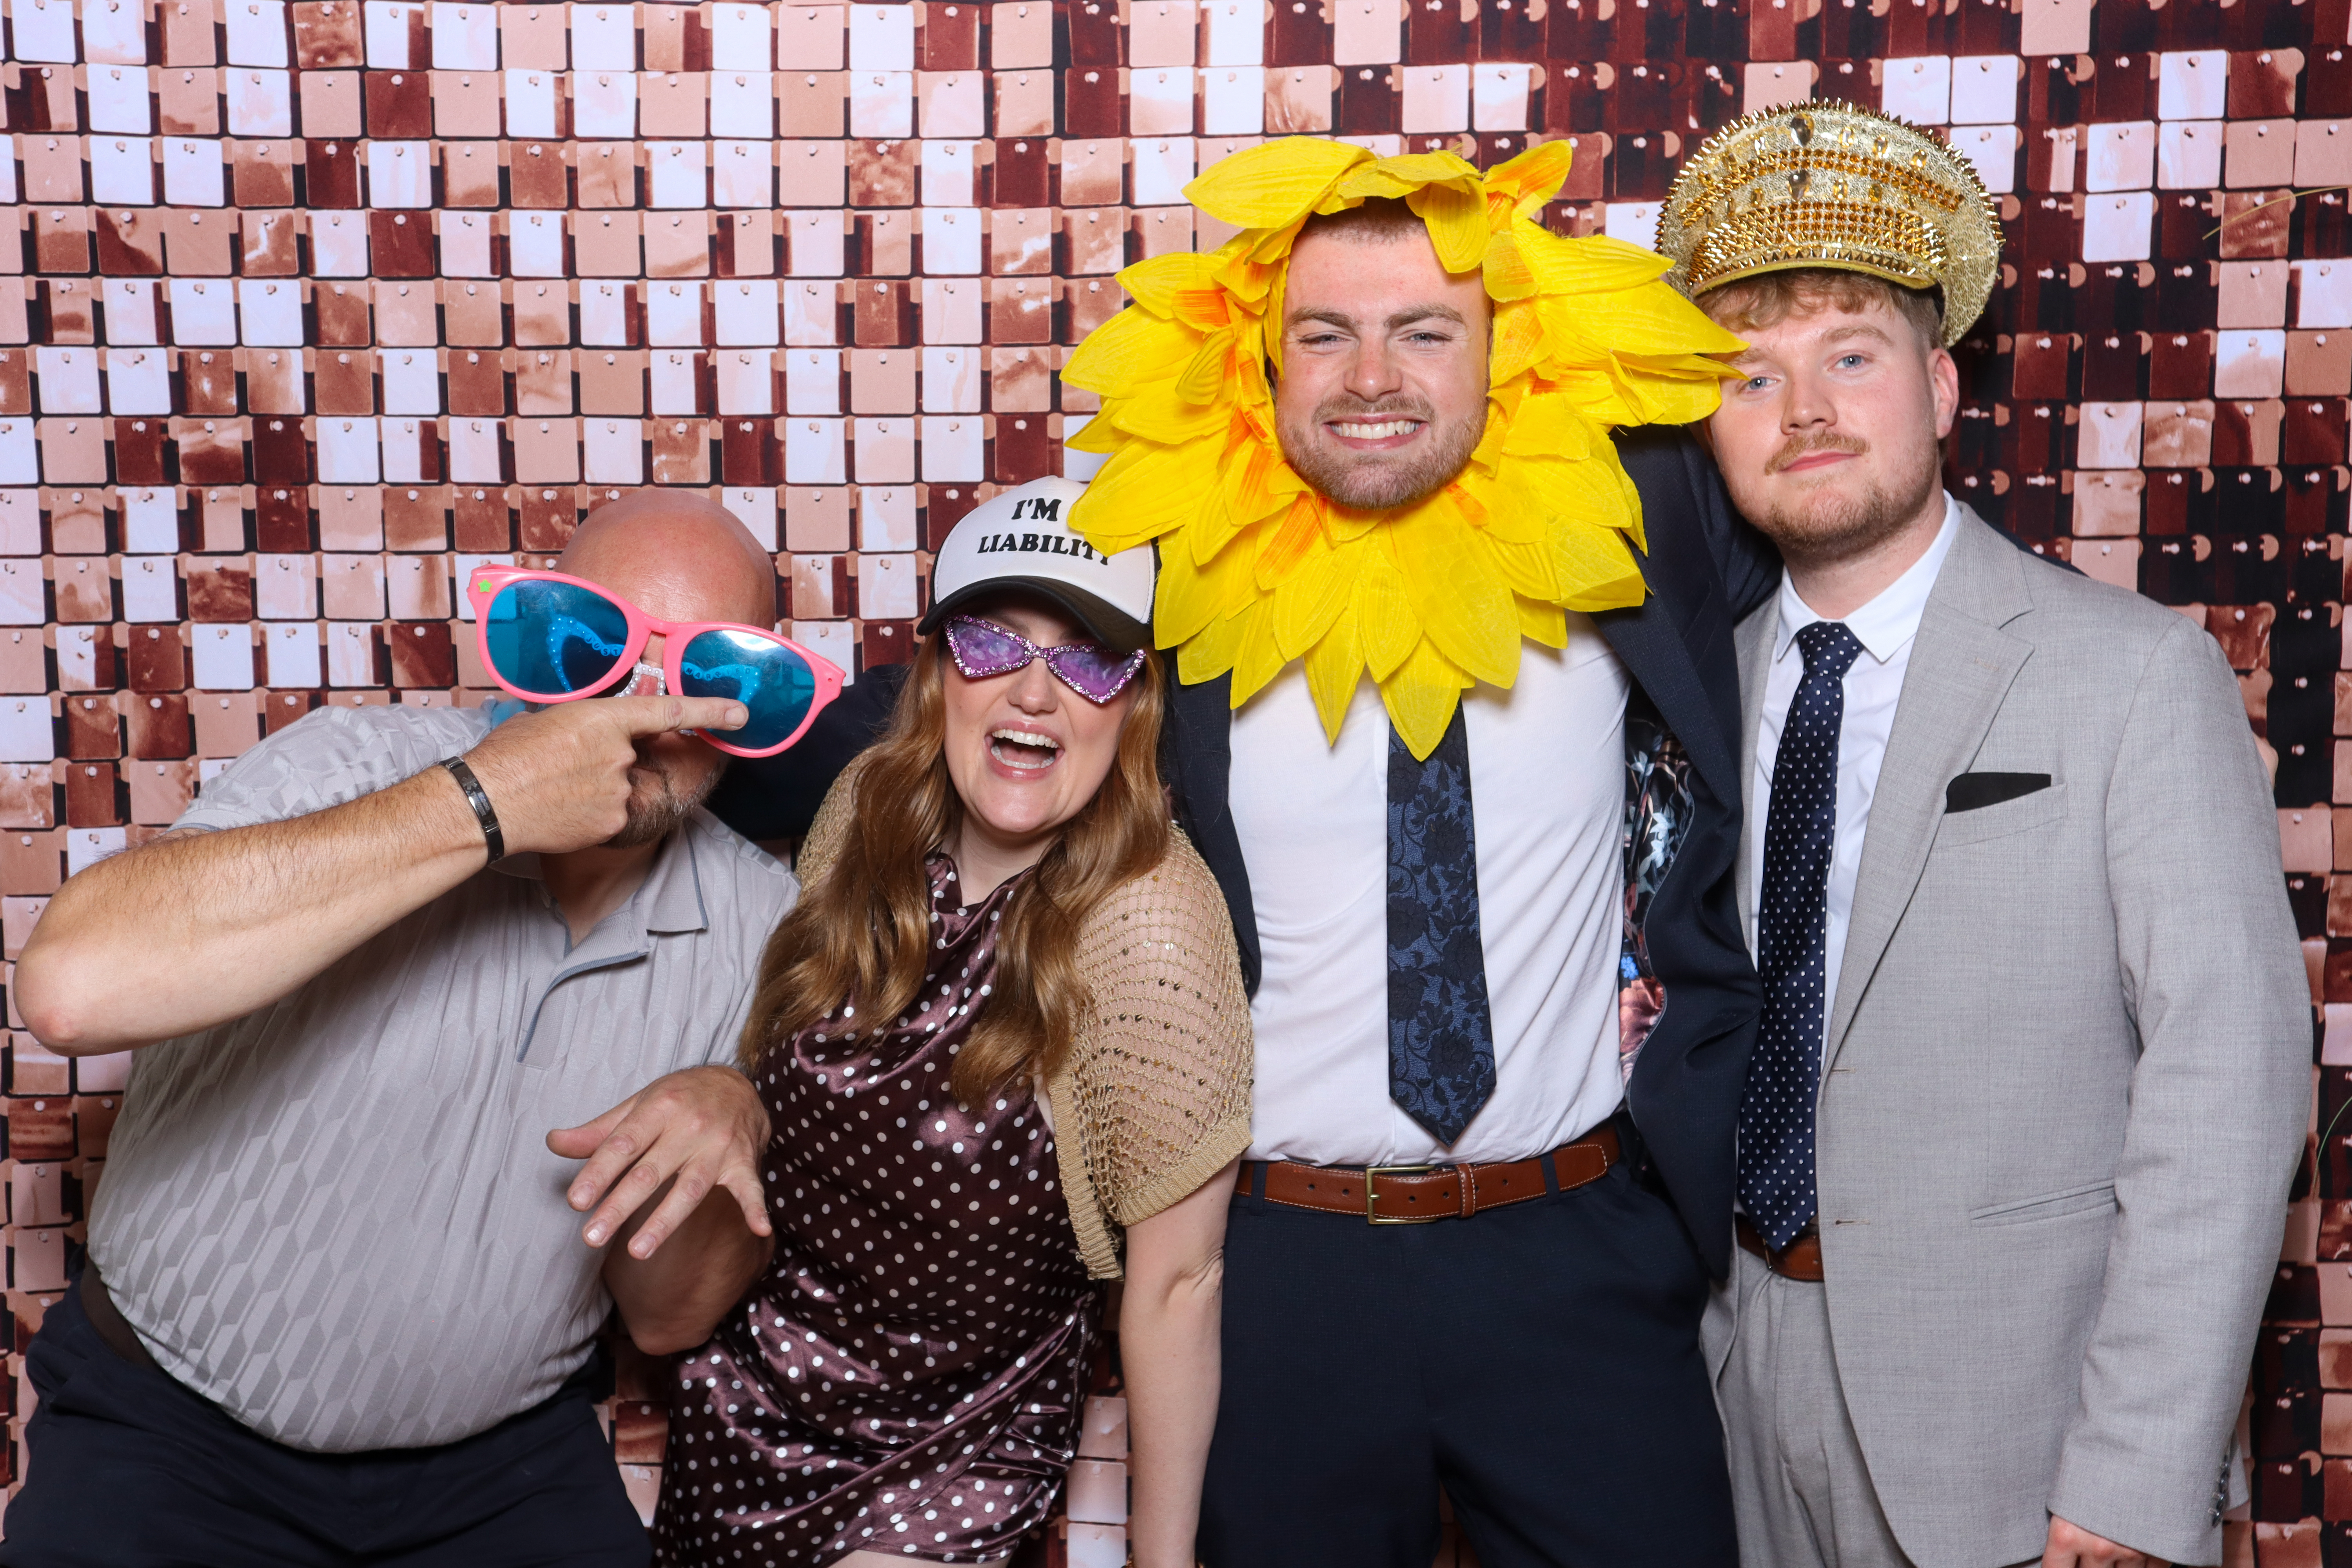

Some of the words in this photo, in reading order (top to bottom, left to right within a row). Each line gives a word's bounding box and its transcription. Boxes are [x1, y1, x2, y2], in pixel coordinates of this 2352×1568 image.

[1011, 498, 1061, 521] I'M
[586, 637, 618, 655] JUST
[686, 667, 750, 680] MARRIED
